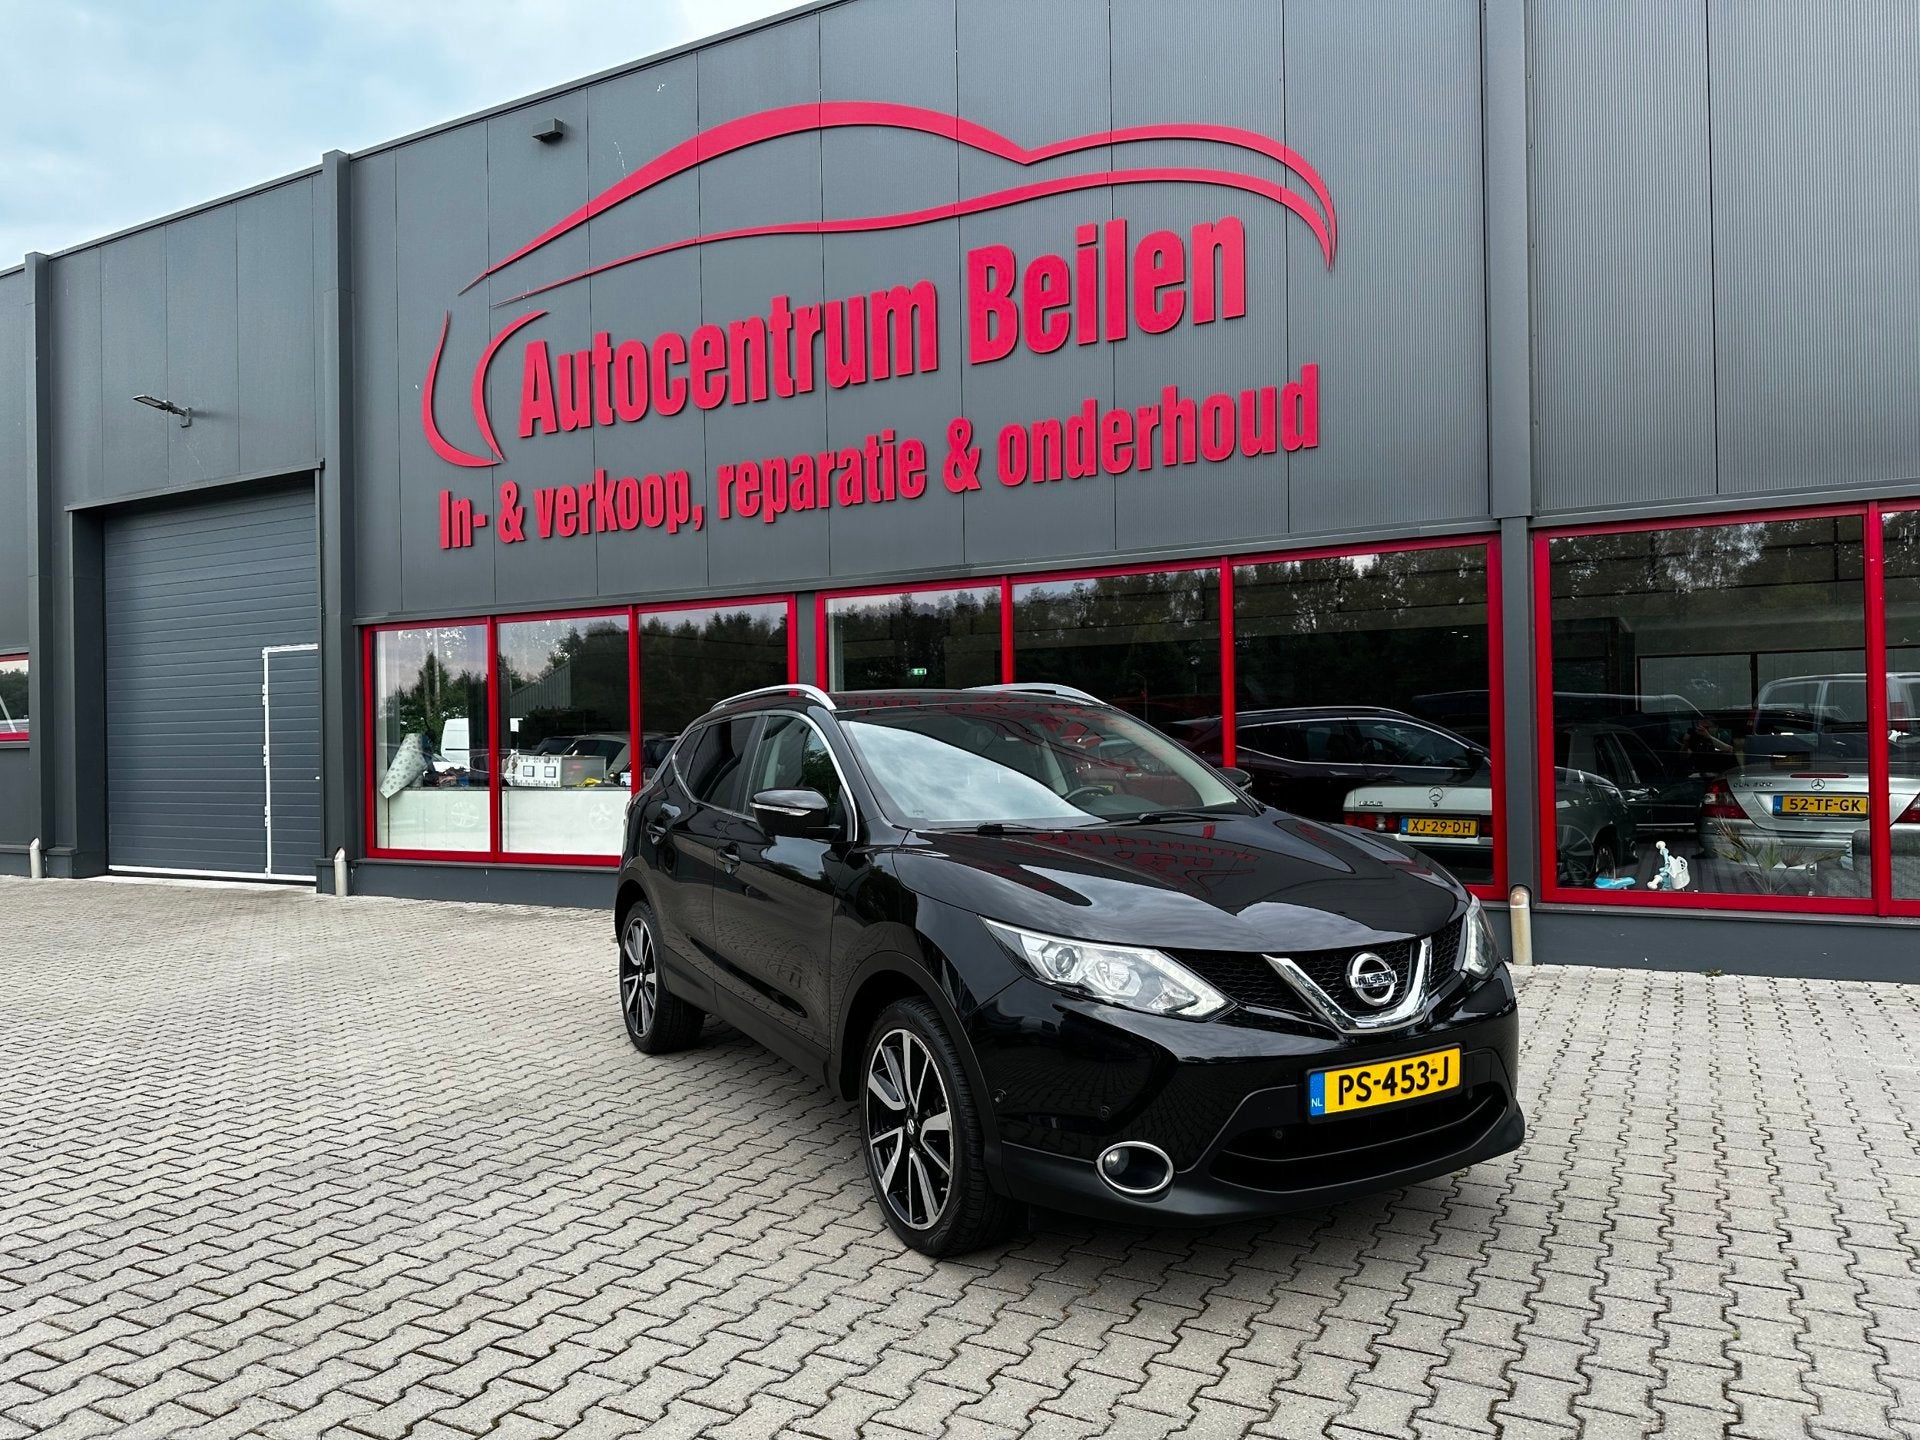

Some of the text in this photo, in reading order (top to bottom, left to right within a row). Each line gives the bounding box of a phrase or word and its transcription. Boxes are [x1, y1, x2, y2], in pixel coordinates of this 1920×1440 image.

[518, 216, 1246, 438] Autocentrum Beilen
[439, 363, 1319, 549] In- & verkoop, reparatie & onderhoud
[1789, 798, 1861, 812] 52-TF-GK
[1411, 820, 1472, 833] XJ-29-DH
[1337, 1056, 1449, 1106] PS-453-J
[1311, 1097, 1323, 1108] NL
